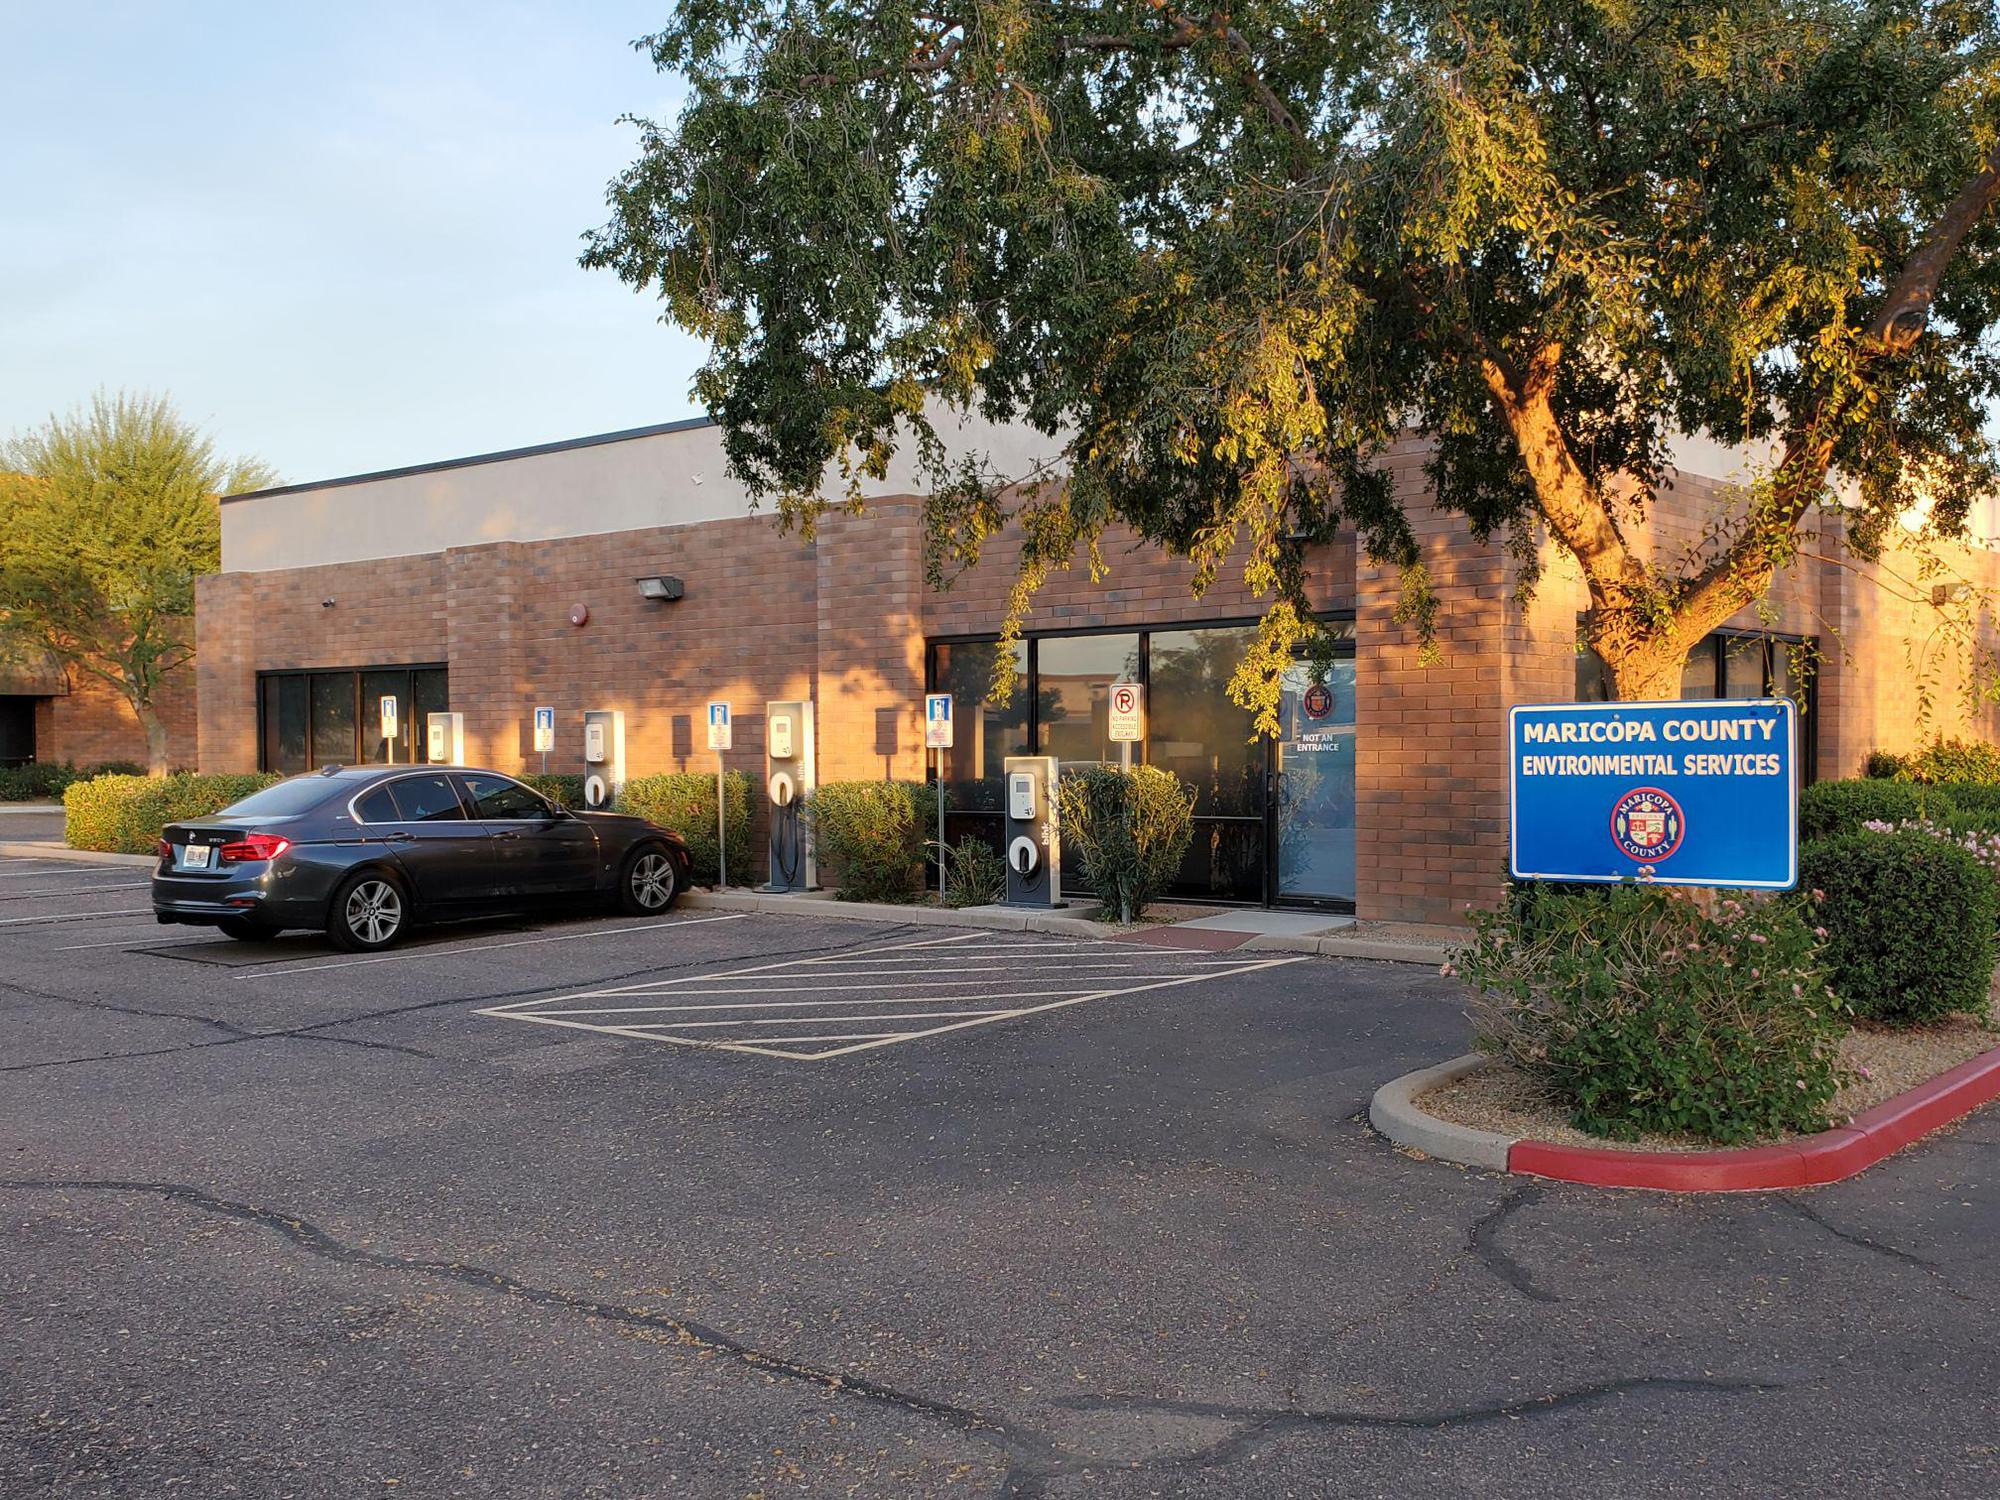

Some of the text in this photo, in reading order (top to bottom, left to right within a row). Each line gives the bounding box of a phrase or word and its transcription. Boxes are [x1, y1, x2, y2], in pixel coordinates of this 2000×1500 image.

[1302, 734, 1333, 742] NOT AN
[1524, 718, 1777, 743] MARICOPA COUNTY
[1297, 743, 1339, 751] ENTRANCE
[1522, 753, 1781, 776] ENVIRONMENTAL SERVICES
[1619, 793, 1674, 815] MARICOPA
[1623, 840, 1670, 857] COUNTY
